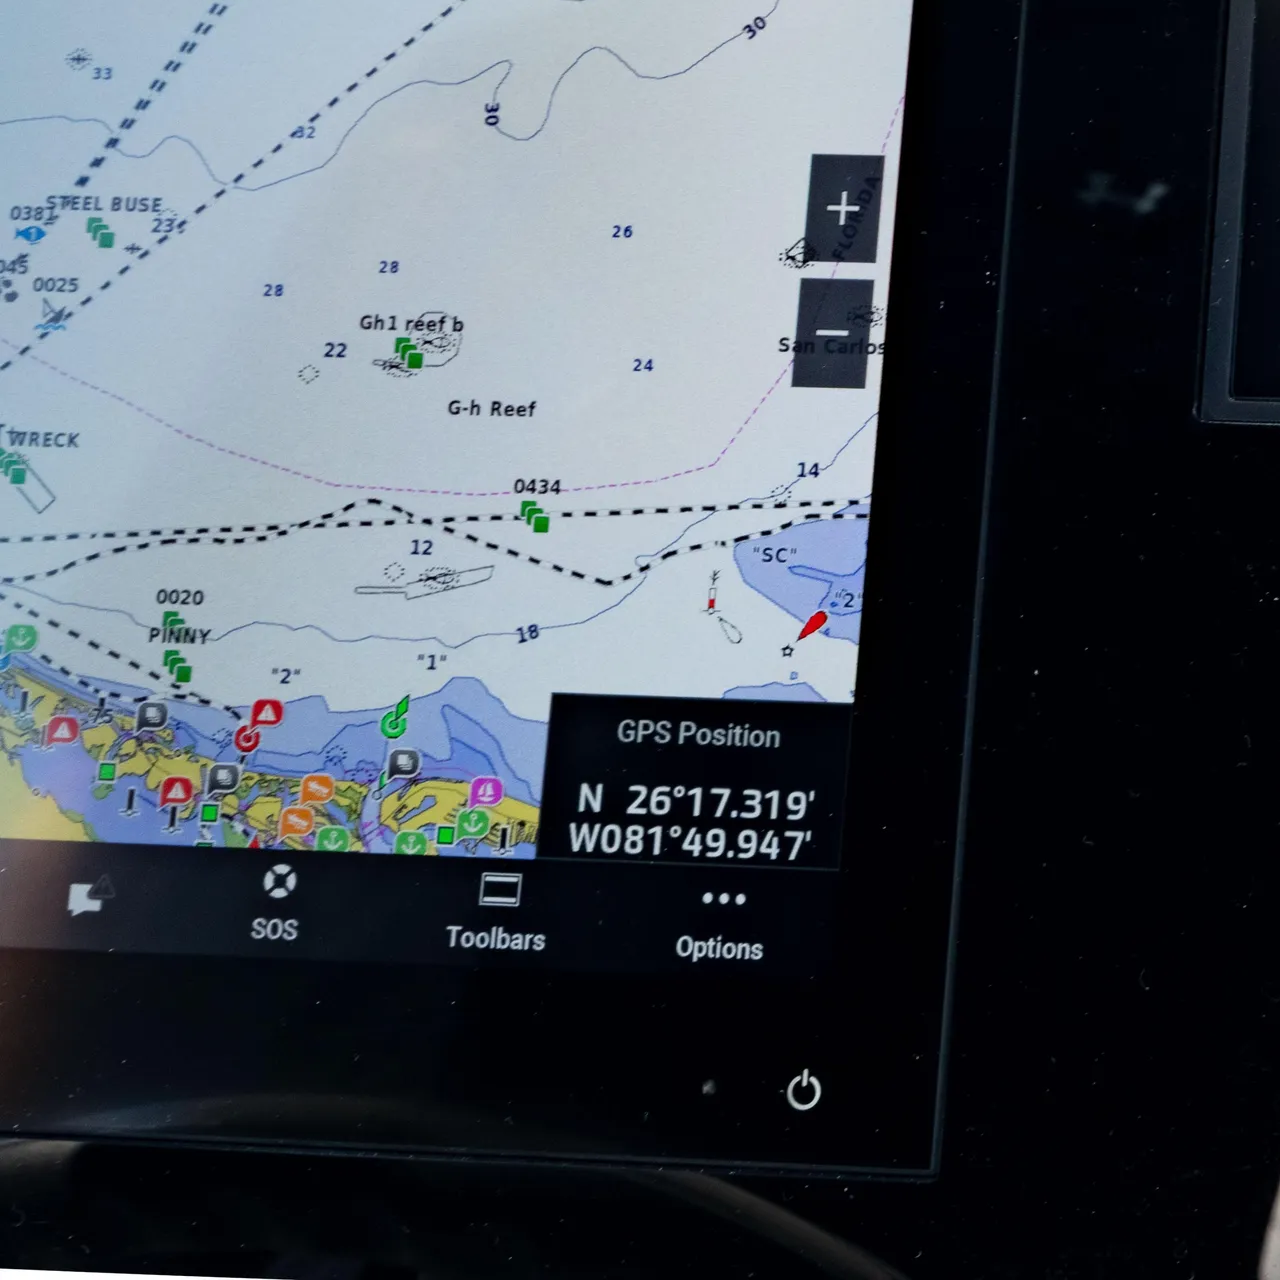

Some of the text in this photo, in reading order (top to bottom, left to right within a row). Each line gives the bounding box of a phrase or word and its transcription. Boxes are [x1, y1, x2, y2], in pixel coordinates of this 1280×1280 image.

[741, 15, 767, 40] 30
[92, 68, 113, 80] 33
[484, 101, 499, 127] 30
[46, 195, 163, 212] STEEL BUSE
[151, 218, 175, 233] 23
[612, 225, 633, 239] 26
[379, 261, 400, 274] 28
[33, 277, 79, 293] 0025
[263, 284, 284, 297] 28
[405, 315, 446, 332] reef
[324, 343, 347, 358] 22
[778, 337, 886, 355] San Carlos
[633, 359, 654, 372] 24
[490, 401, 537, 417] Reef
[797, 462, 820, 478] 14
[513, 478, 562, 495] 0434
[410, 540, 433, 555] 12
[156, 589, 205, 606] 0020
[148, 627, 212, 645] PINNY
[516, 624, 540, 644] 18
[617, 719, 781, 749] GPS Position
[578, 783, 604, 813] N
[250, 918, 299, 941] SOS
[447, 925, 546, 952] Toolbars
[676, 934, 764, 962] Options
